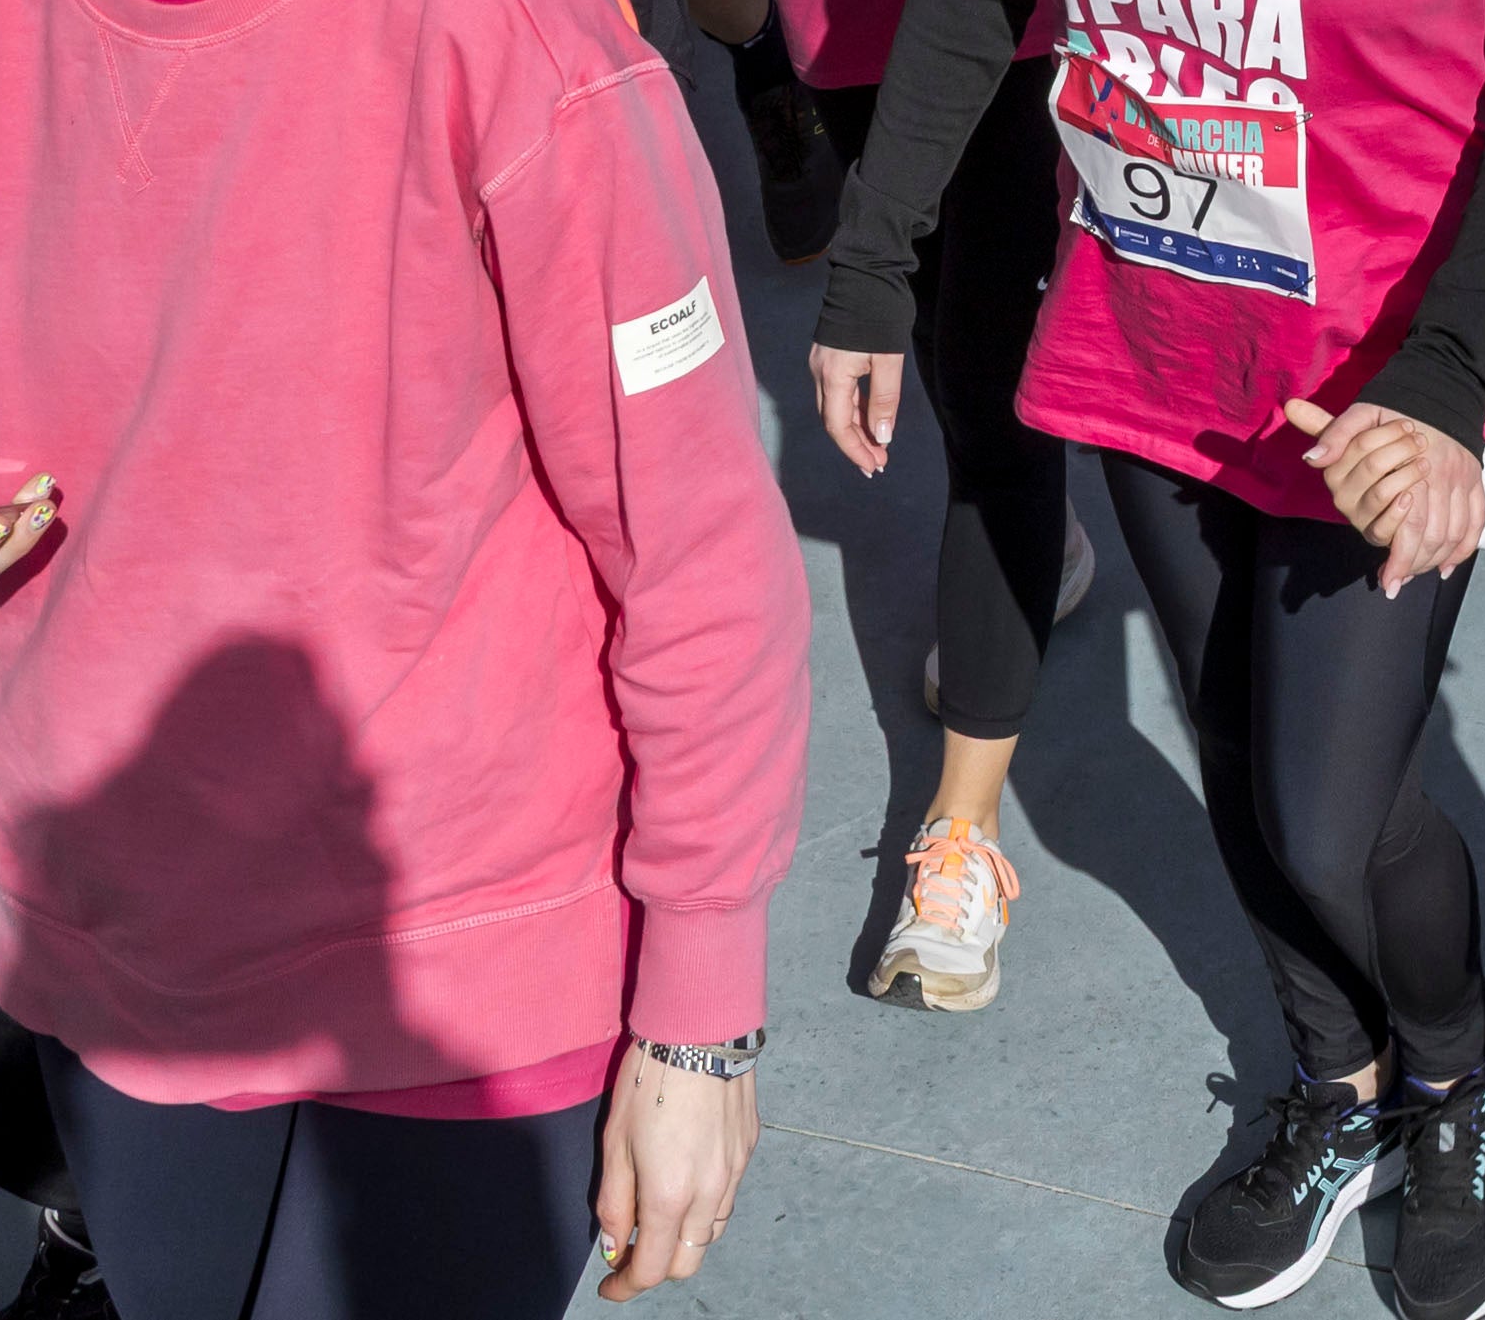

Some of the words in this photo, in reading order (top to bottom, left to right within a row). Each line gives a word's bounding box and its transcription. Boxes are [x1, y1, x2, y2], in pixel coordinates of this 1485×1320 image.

[1172, 148, 1264, 187] MUJER
[1123, 162, 1218, 231] 97
[650, 299, 697, 335] ECOALF
